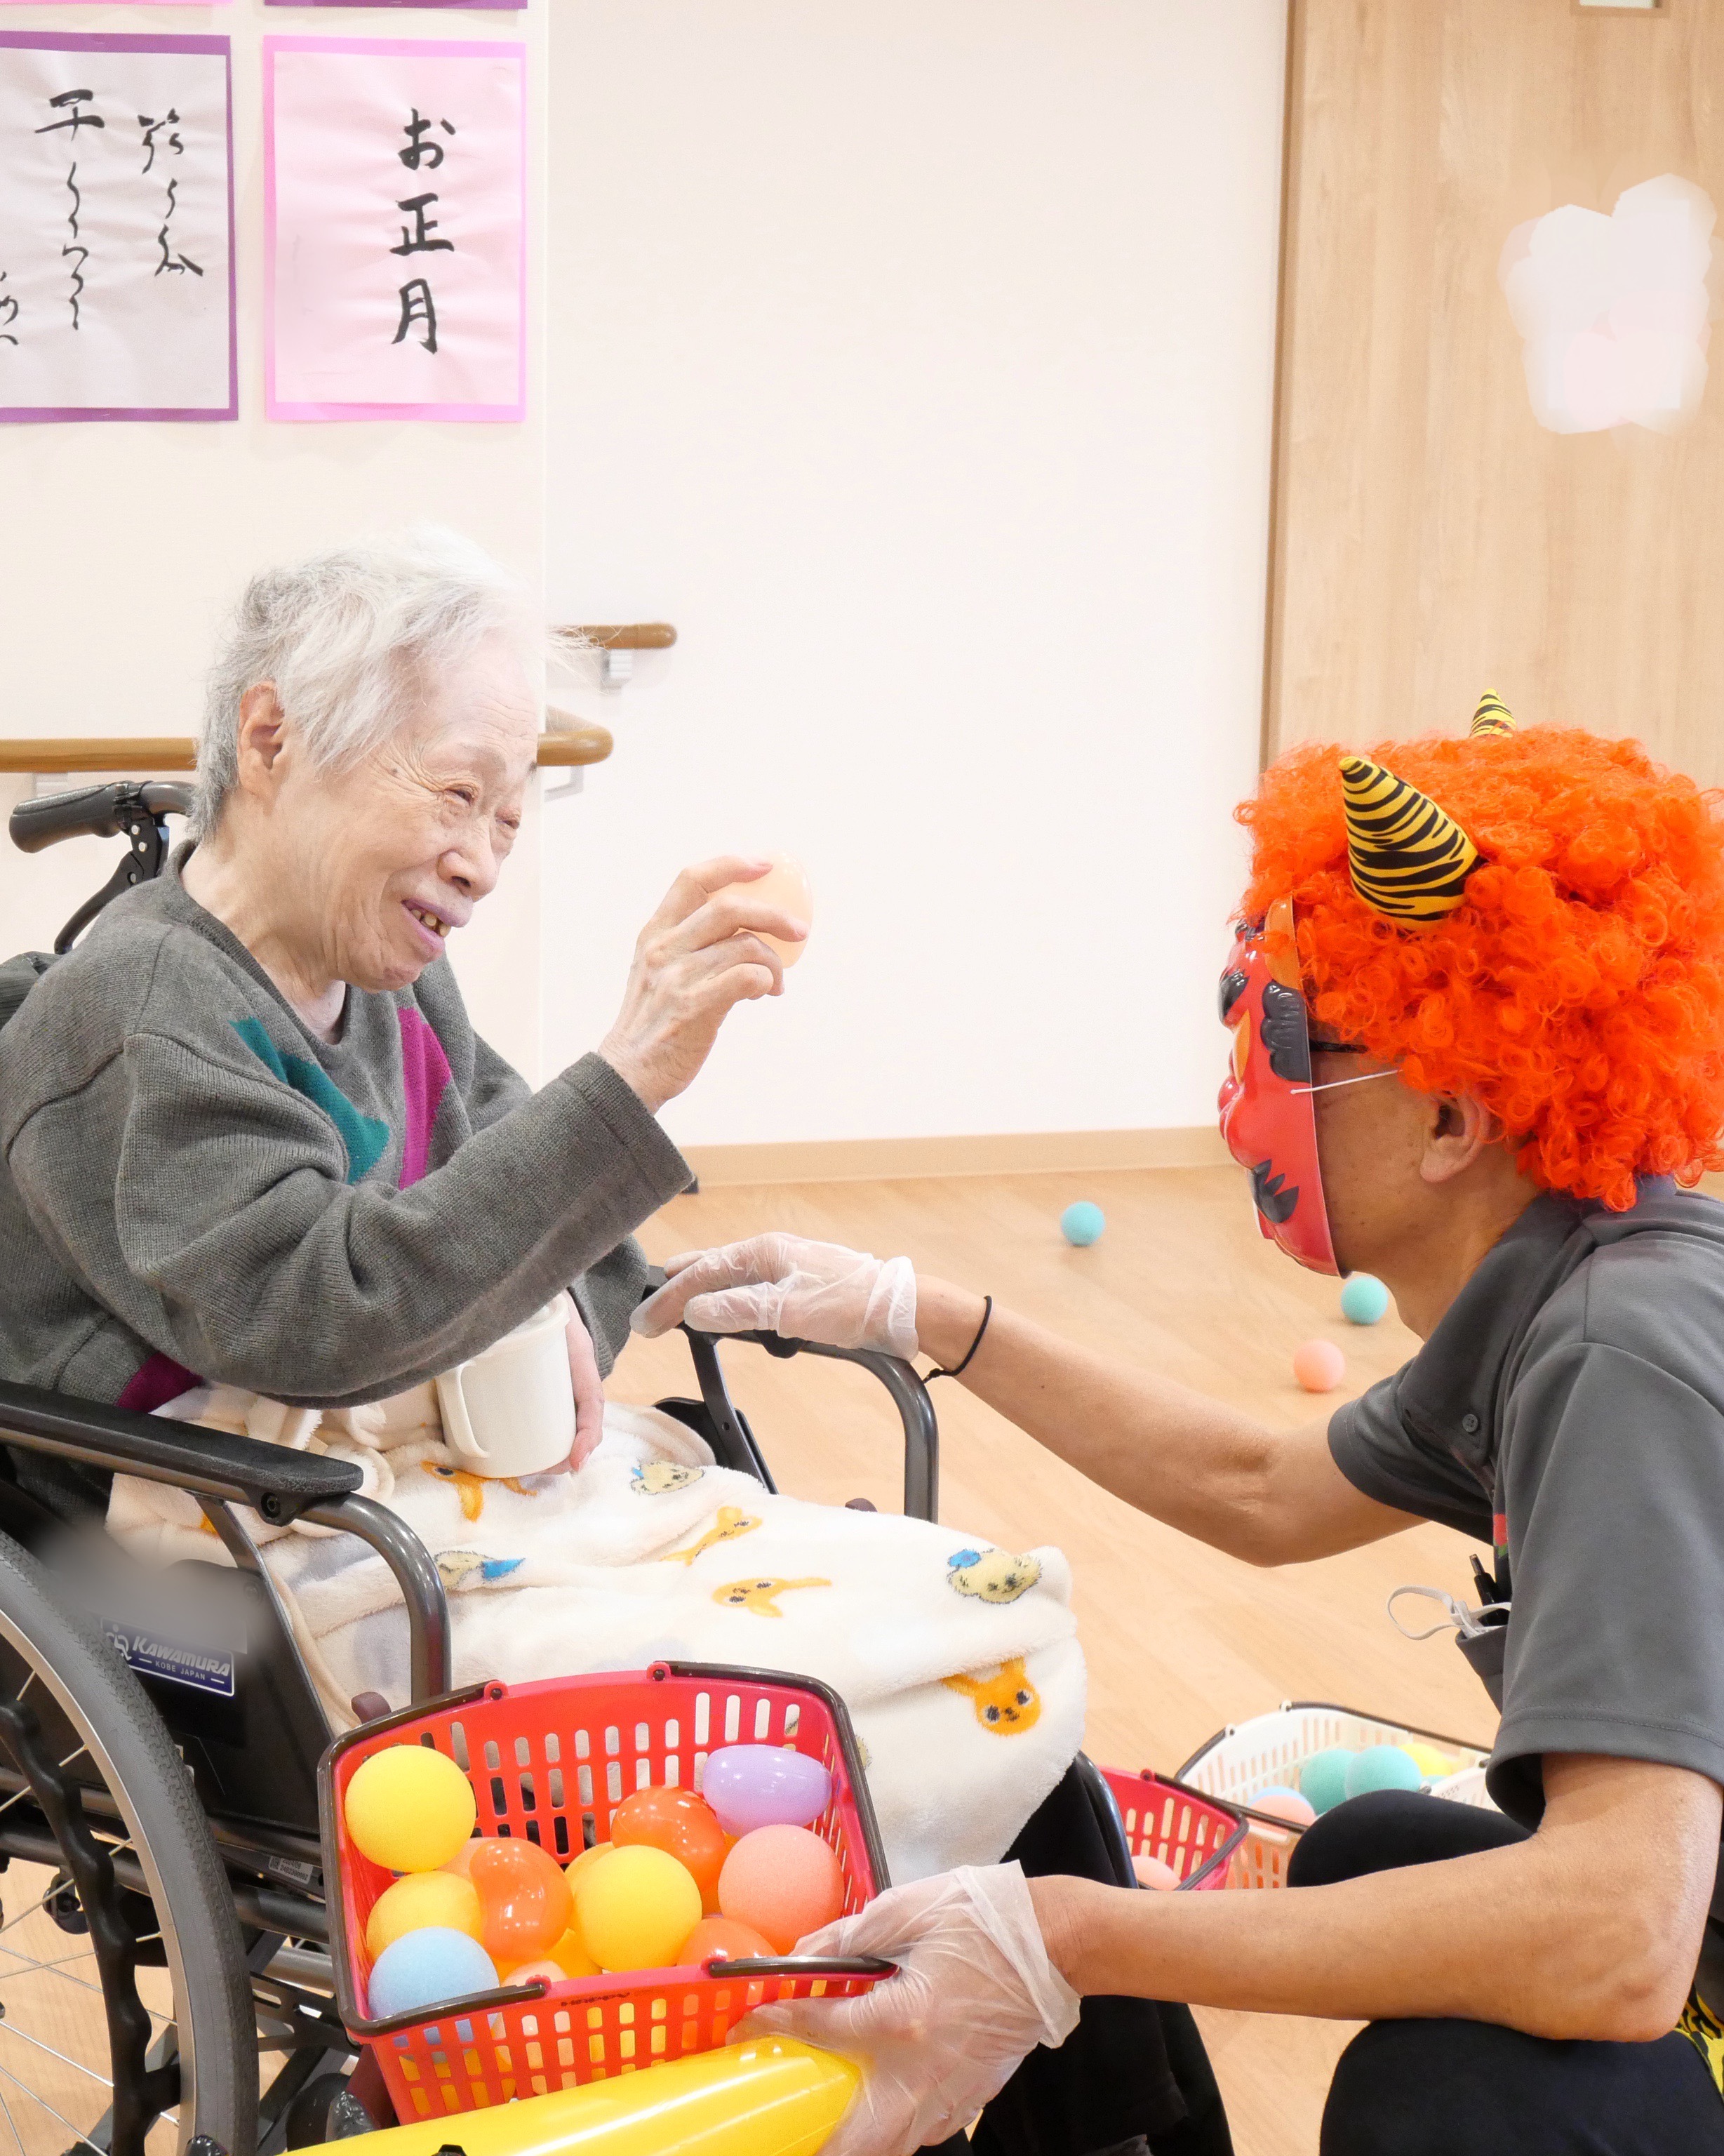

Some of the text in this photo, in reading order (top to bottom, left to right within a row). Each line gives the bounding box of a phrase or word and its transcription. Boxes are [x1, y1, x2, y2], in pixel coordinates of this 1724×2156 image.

[389, 107, 457, 355] お正月
[132, 1635, 230, 1677] KAWAMURA
[155, 1660, 206, 1681] KOBE JAPAN
